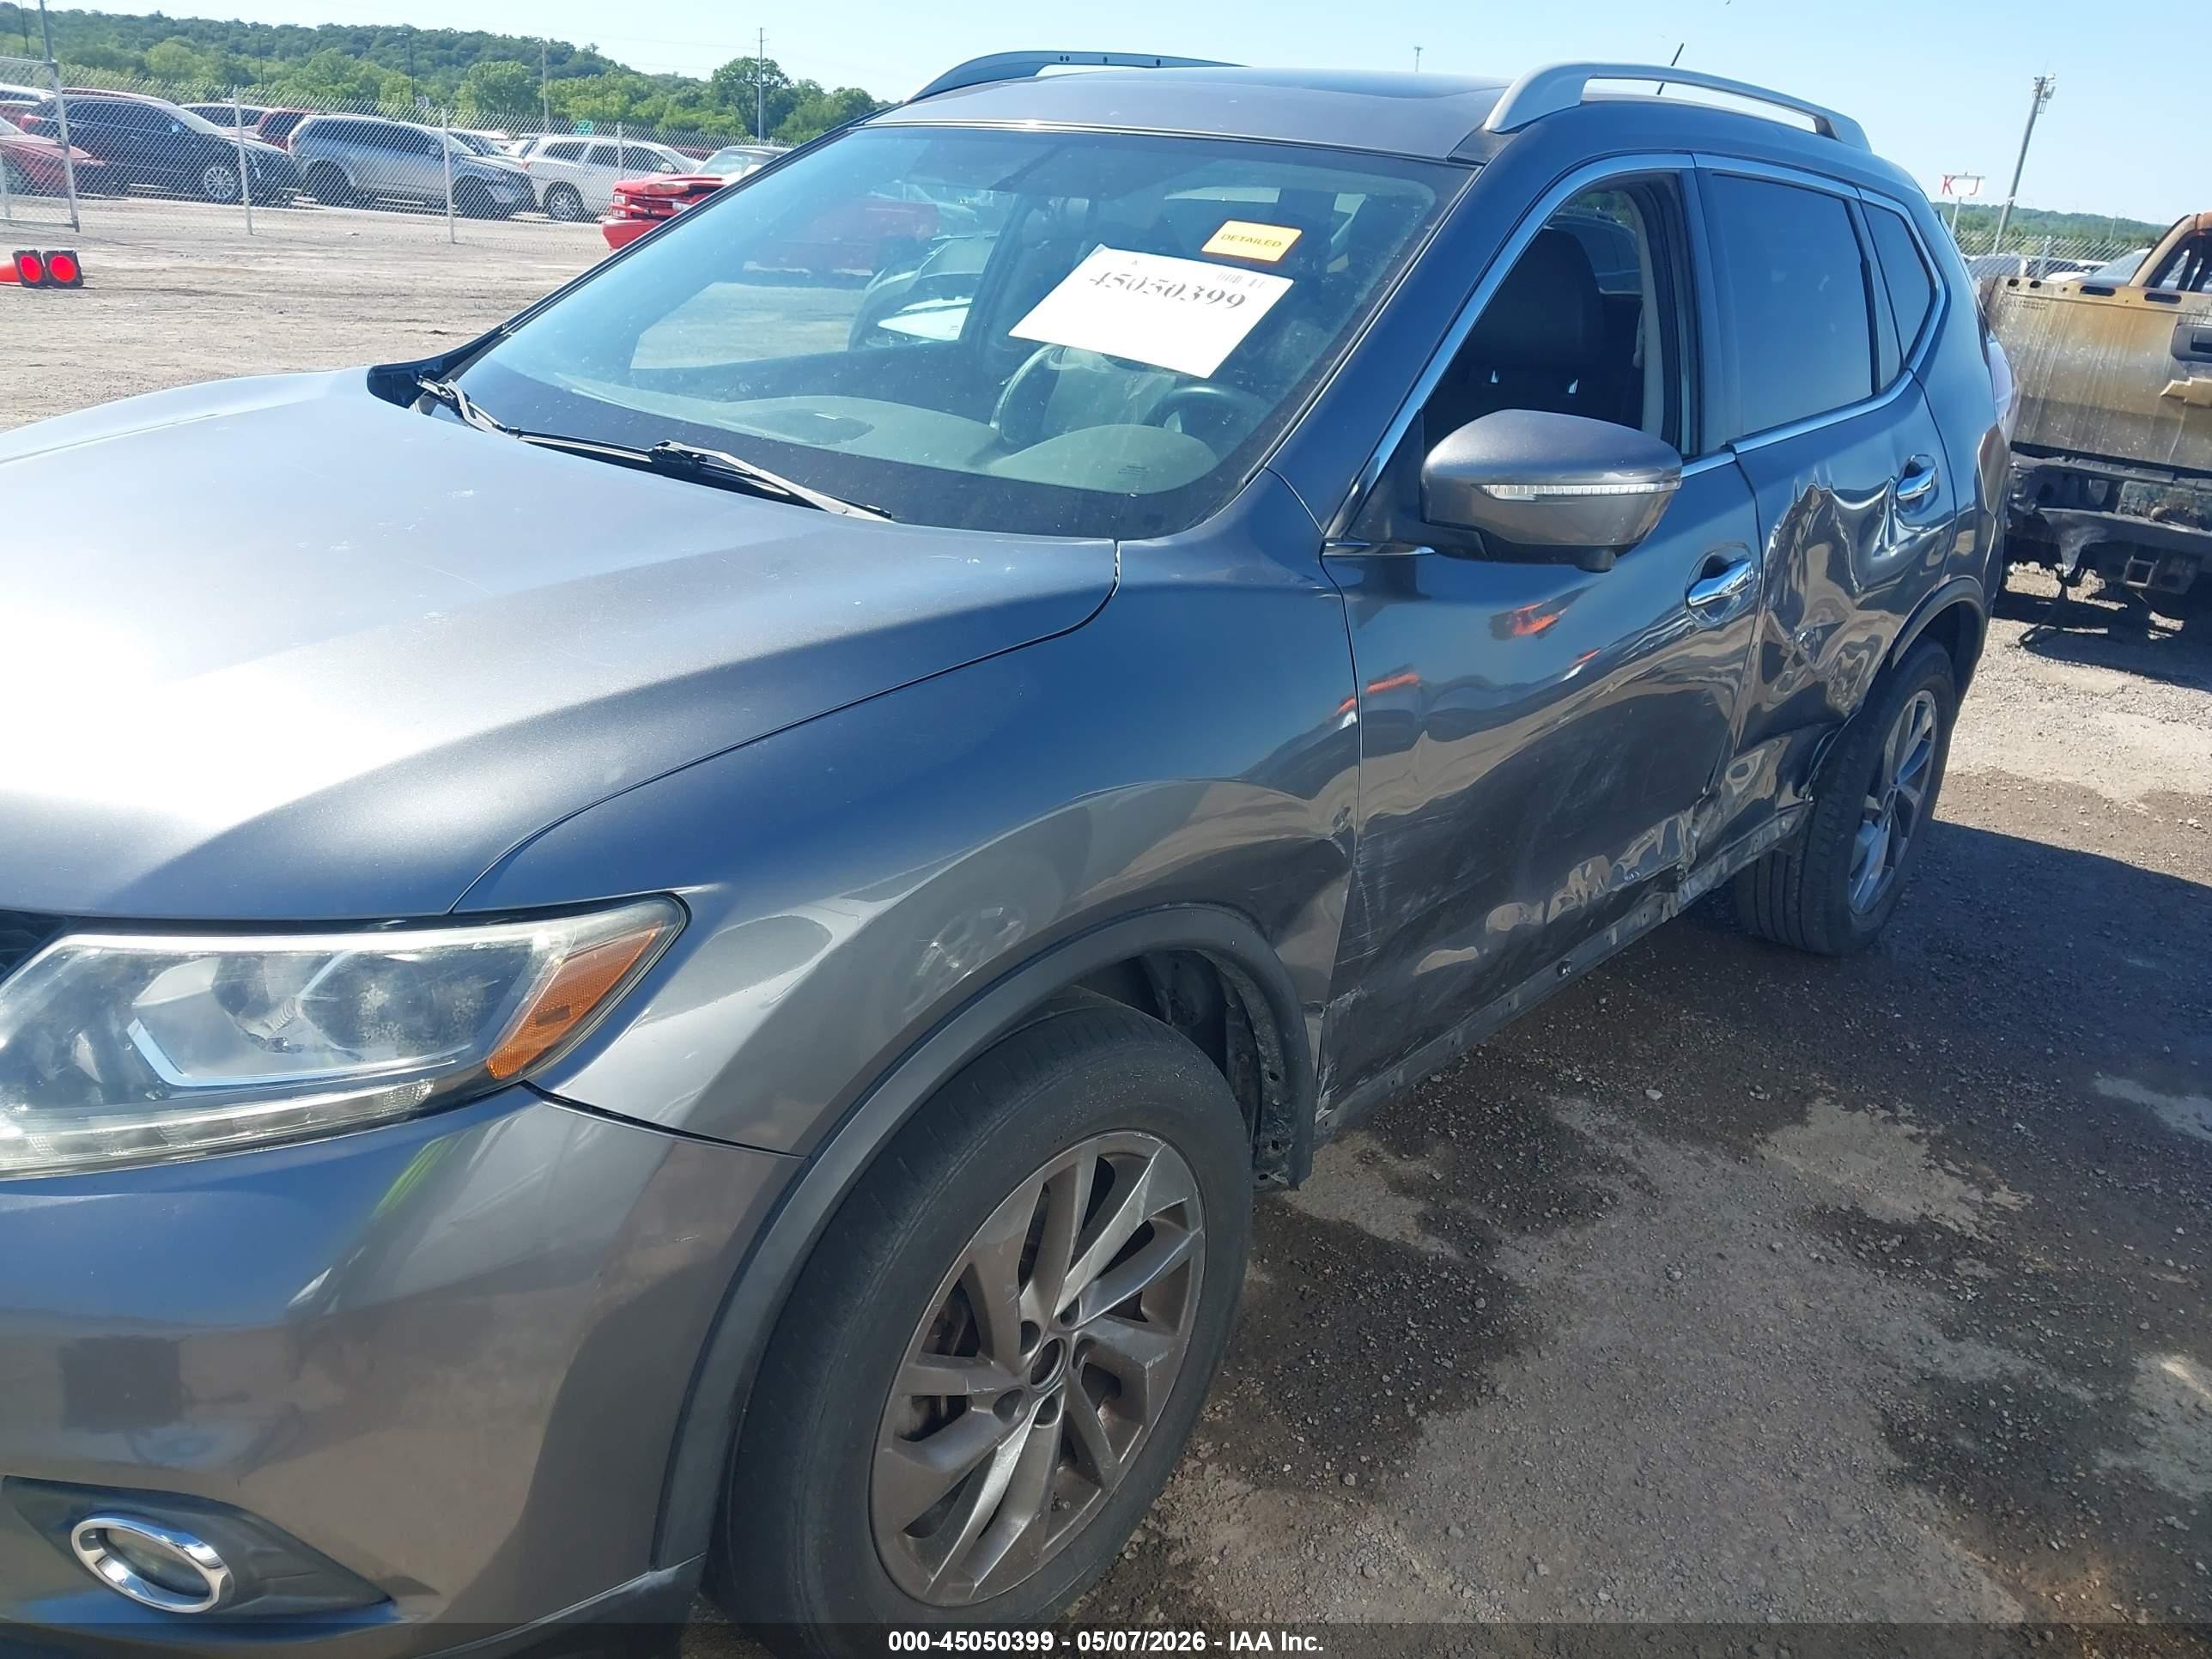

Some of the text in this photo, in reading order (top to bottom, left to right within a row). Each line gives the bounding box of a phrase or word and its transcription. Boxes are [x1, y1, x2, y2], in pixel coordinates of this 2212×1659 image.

[1942, 175, 1956, 195] K
[1220, 233, 1282, 248] DETAILED
[1089, 270, 1247, 309] 45050399
